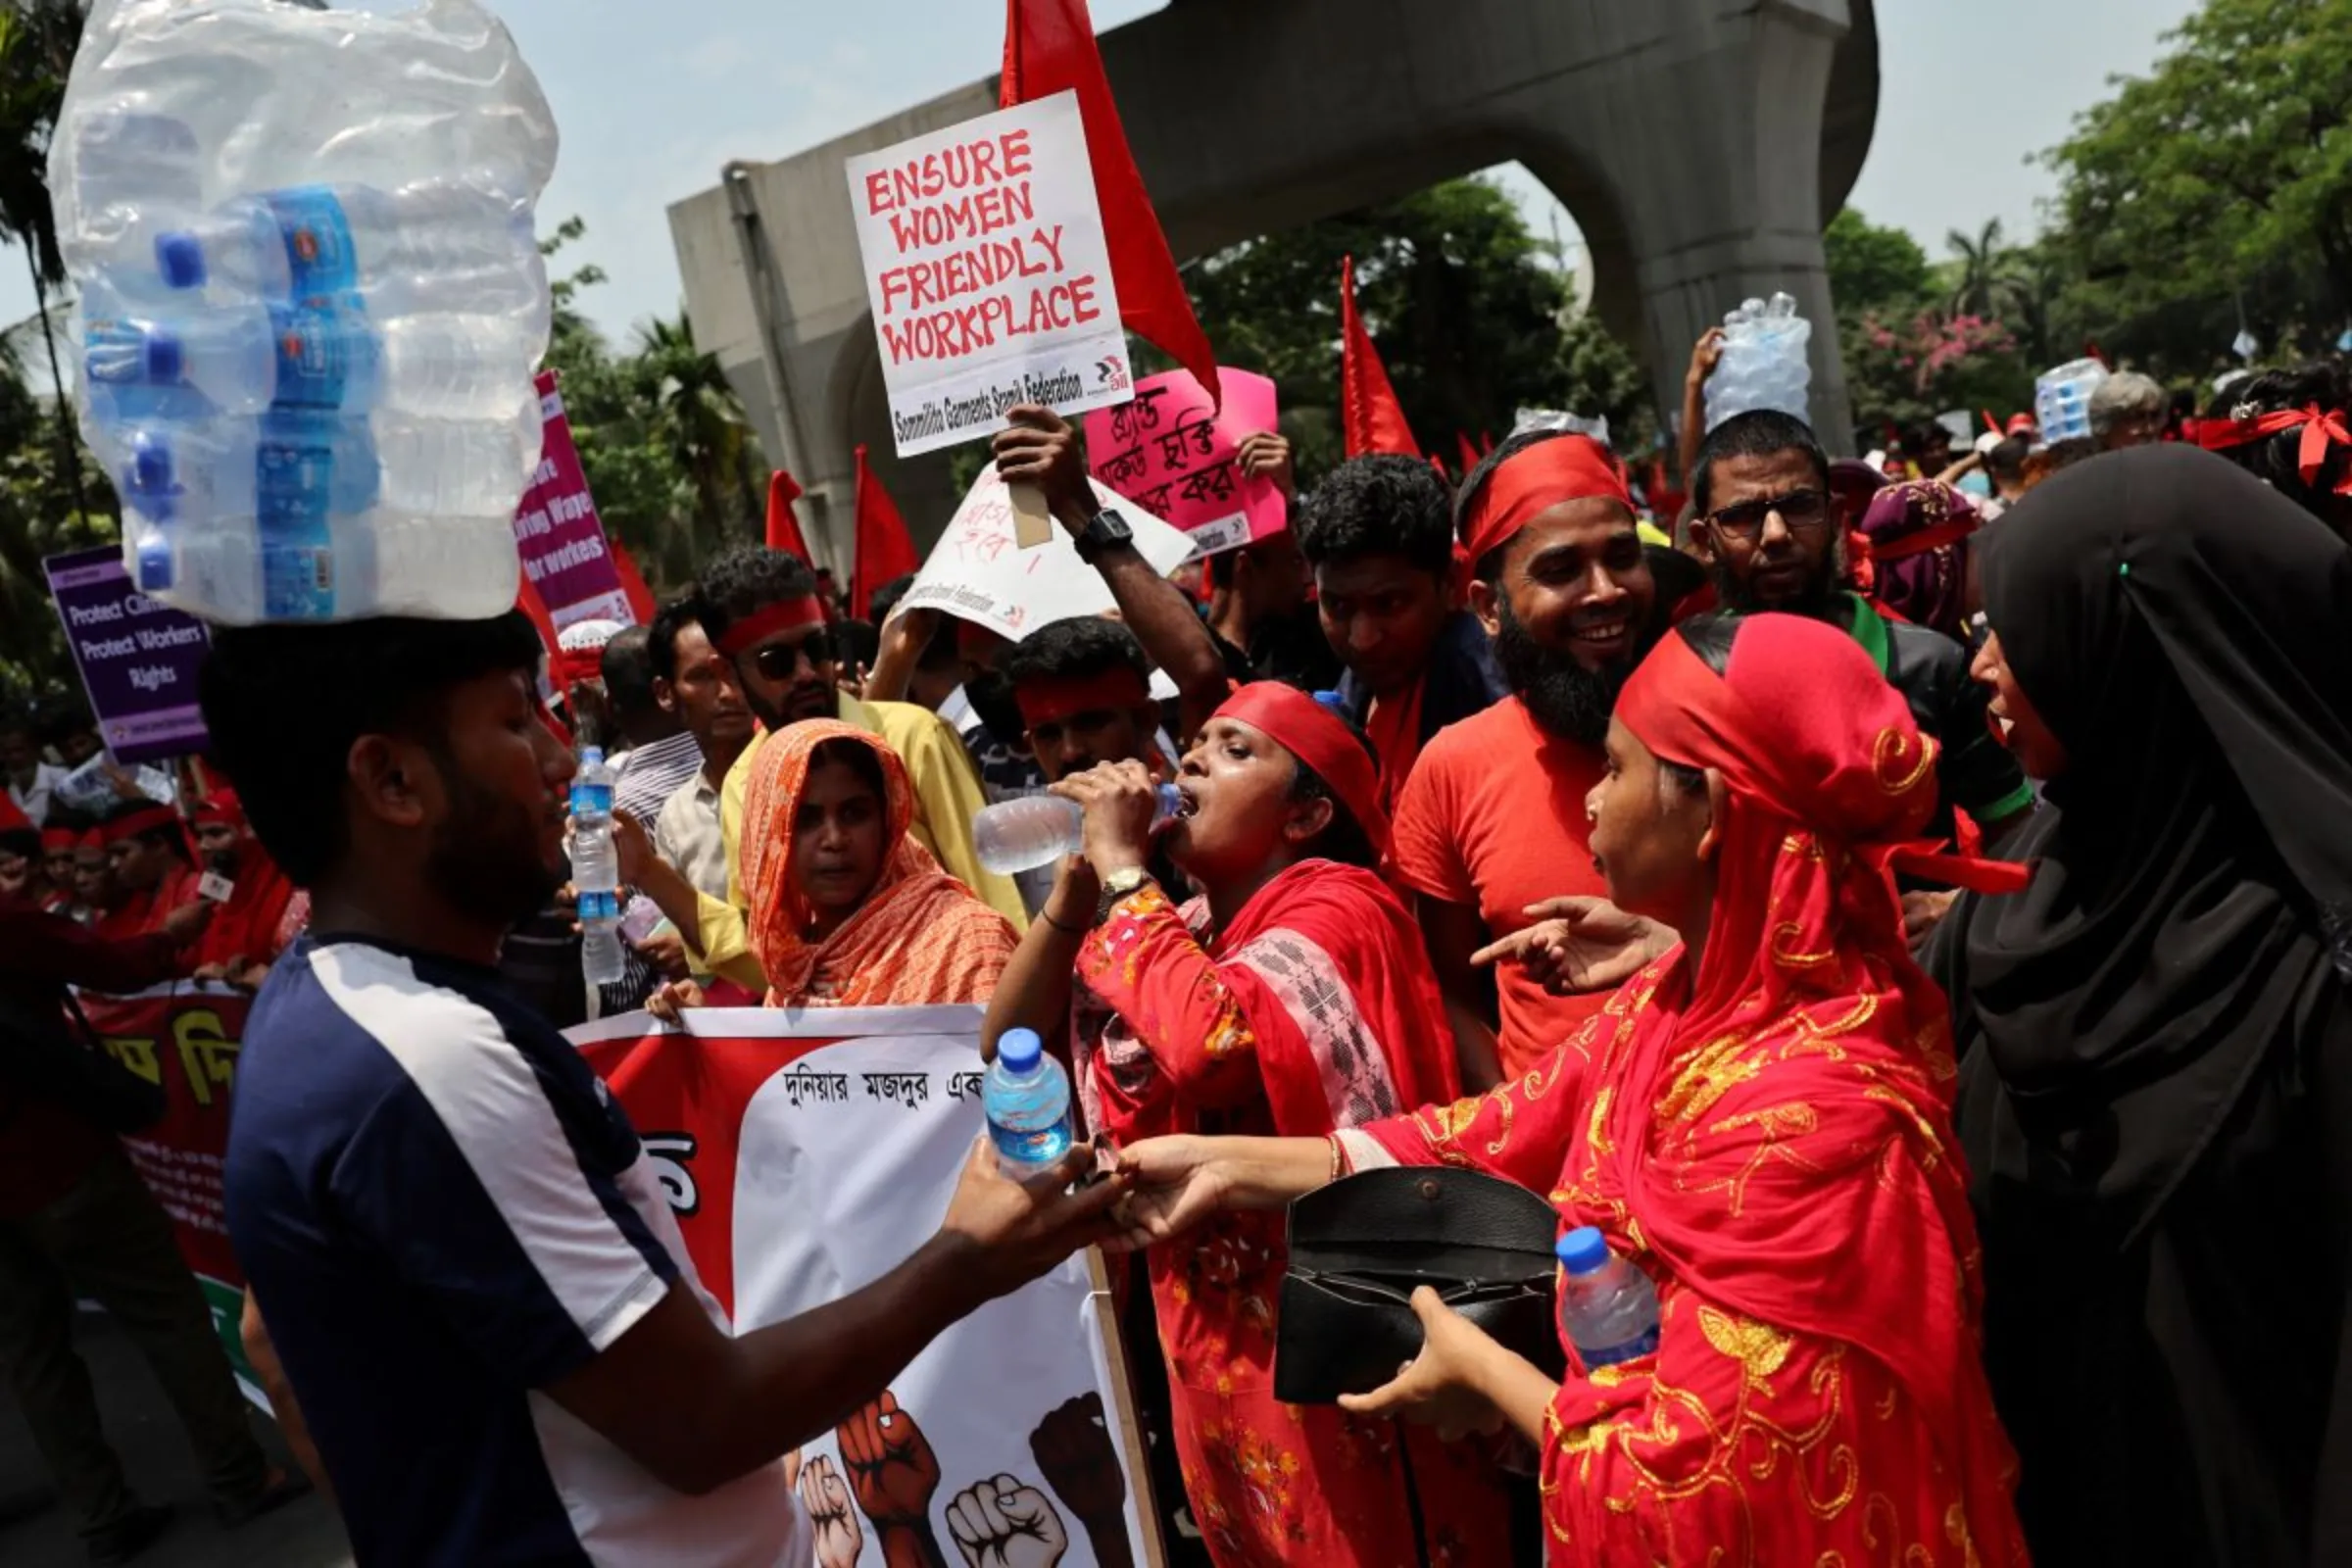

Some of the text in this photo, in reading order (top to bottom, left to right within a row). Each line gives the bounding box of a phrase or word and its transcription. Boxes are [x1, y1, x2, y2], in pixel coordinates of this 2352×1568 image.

[866, 128, 1033, 216] ENSURE
[889, 181, 1034, 253] WOMEN
[879, 224, 1064, 314] FRIENDLY
[882, 274, 1100, 366] WORKPLACE
[945, 391, 993, 431] Garments
[1023, 367, 1083, 407] Federation
[1178, 458, 1237, 502] কর
[69, 602, 123, 625] Protect
[81, 624, 201, 660] Protect Workers
[128, 665, 176, 691] Rights
[784, 1062, 850, 1109] দুনিয়ার
[860, 1073, 929, 1110] মজদুর
